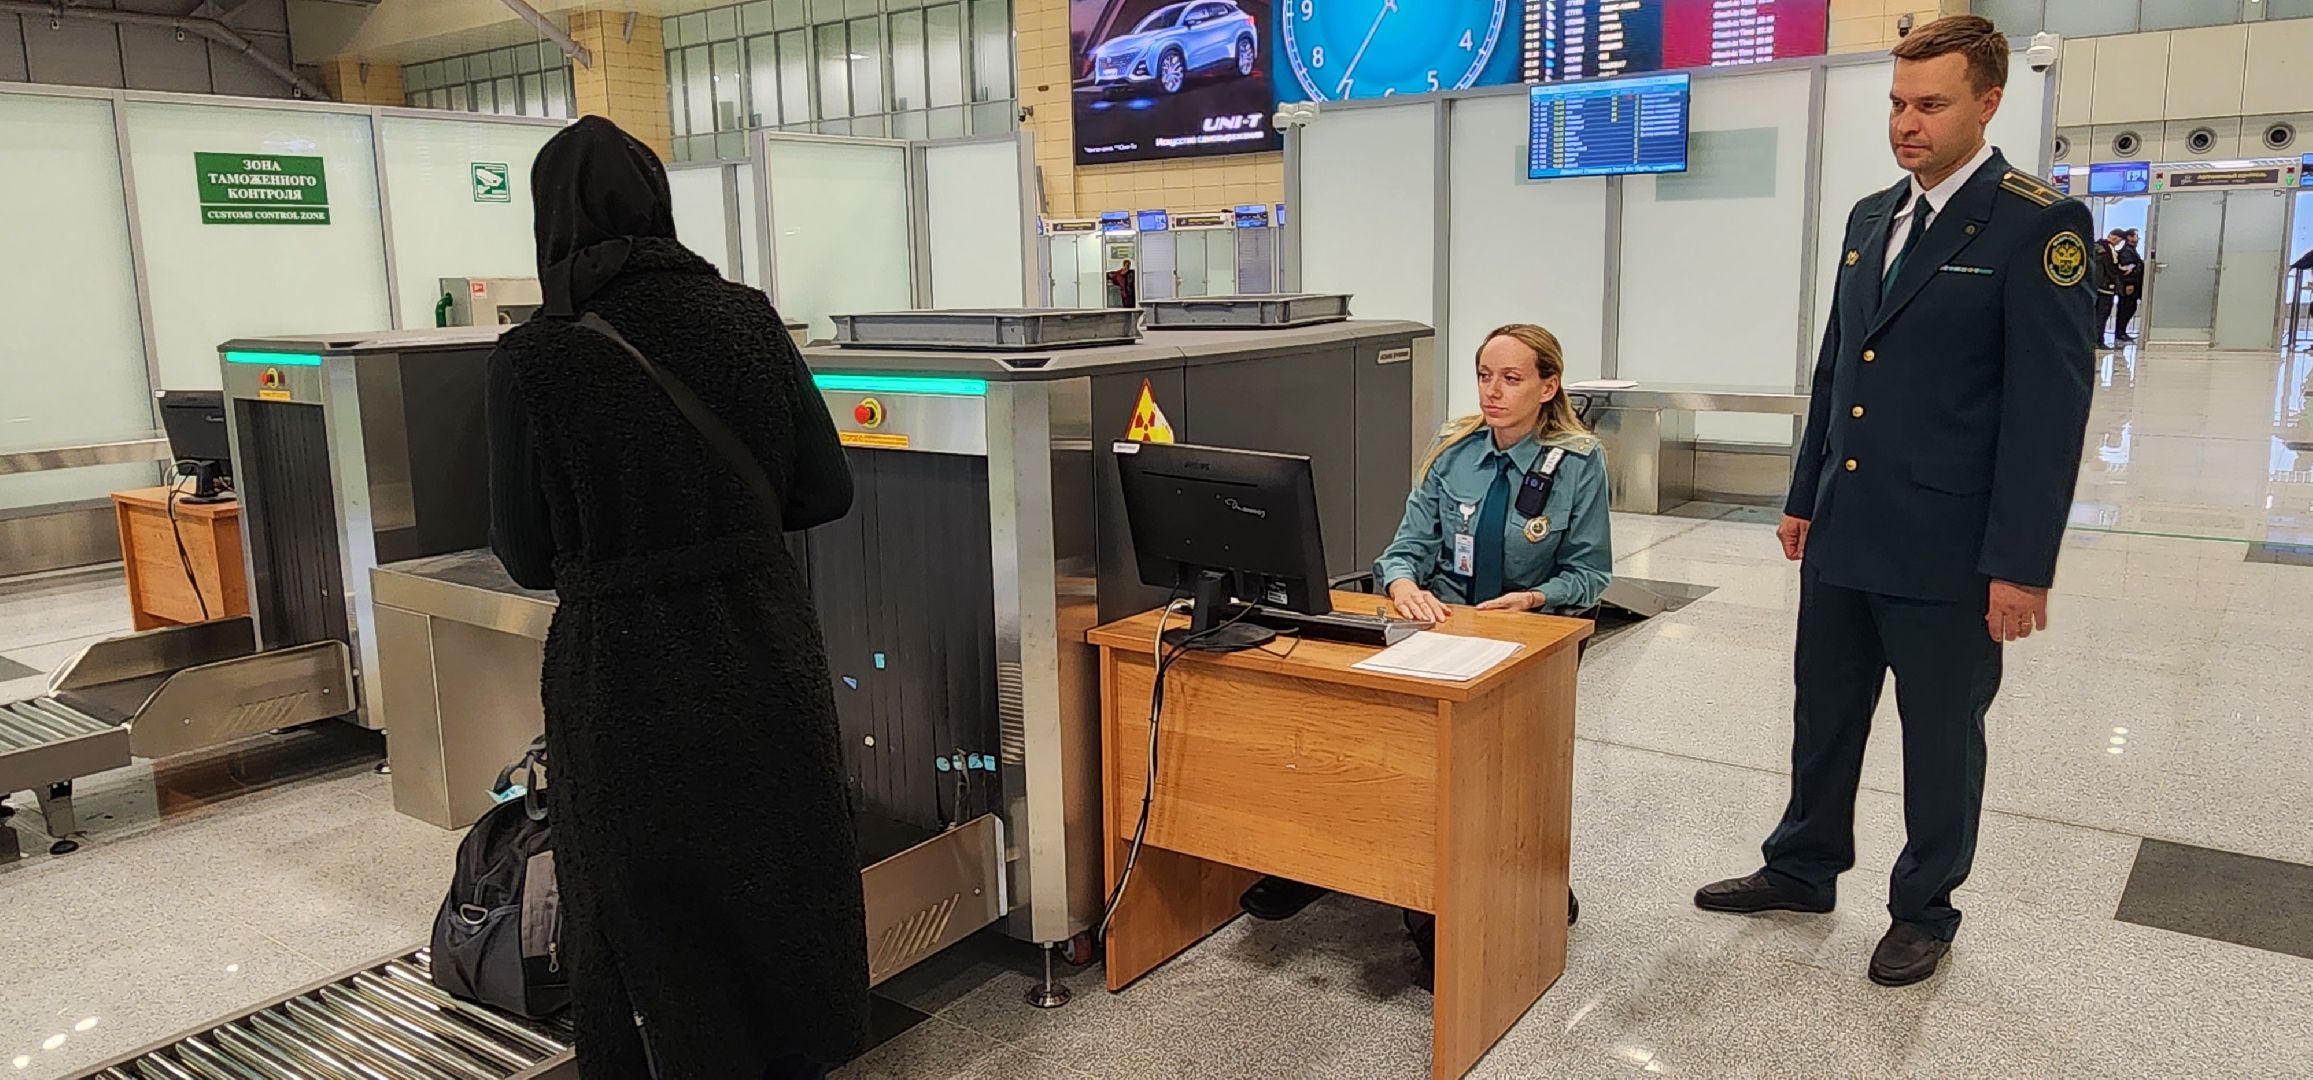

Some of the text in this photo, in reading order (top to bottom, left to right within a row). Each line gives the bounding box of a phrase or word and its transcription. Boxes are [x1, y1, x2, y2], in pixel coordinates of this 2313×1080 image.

[1301, 0, 1313, 21] 9
[1459, 29, 1473, 51] 4
[1312, 46, 1324, 67] 8
[1341, 78, 1354, 100] 7
[1427, 70, 1439, 92] 5
[242, 159, 282, 172] ЗОНА
[207, 173, 317, 187] ТАМОЖЕННОГО
[227, 188, 303, 201] КОНТРОЛЯ
[207, 211, 326, 220] CUSTOMS CONTROL ZONE
